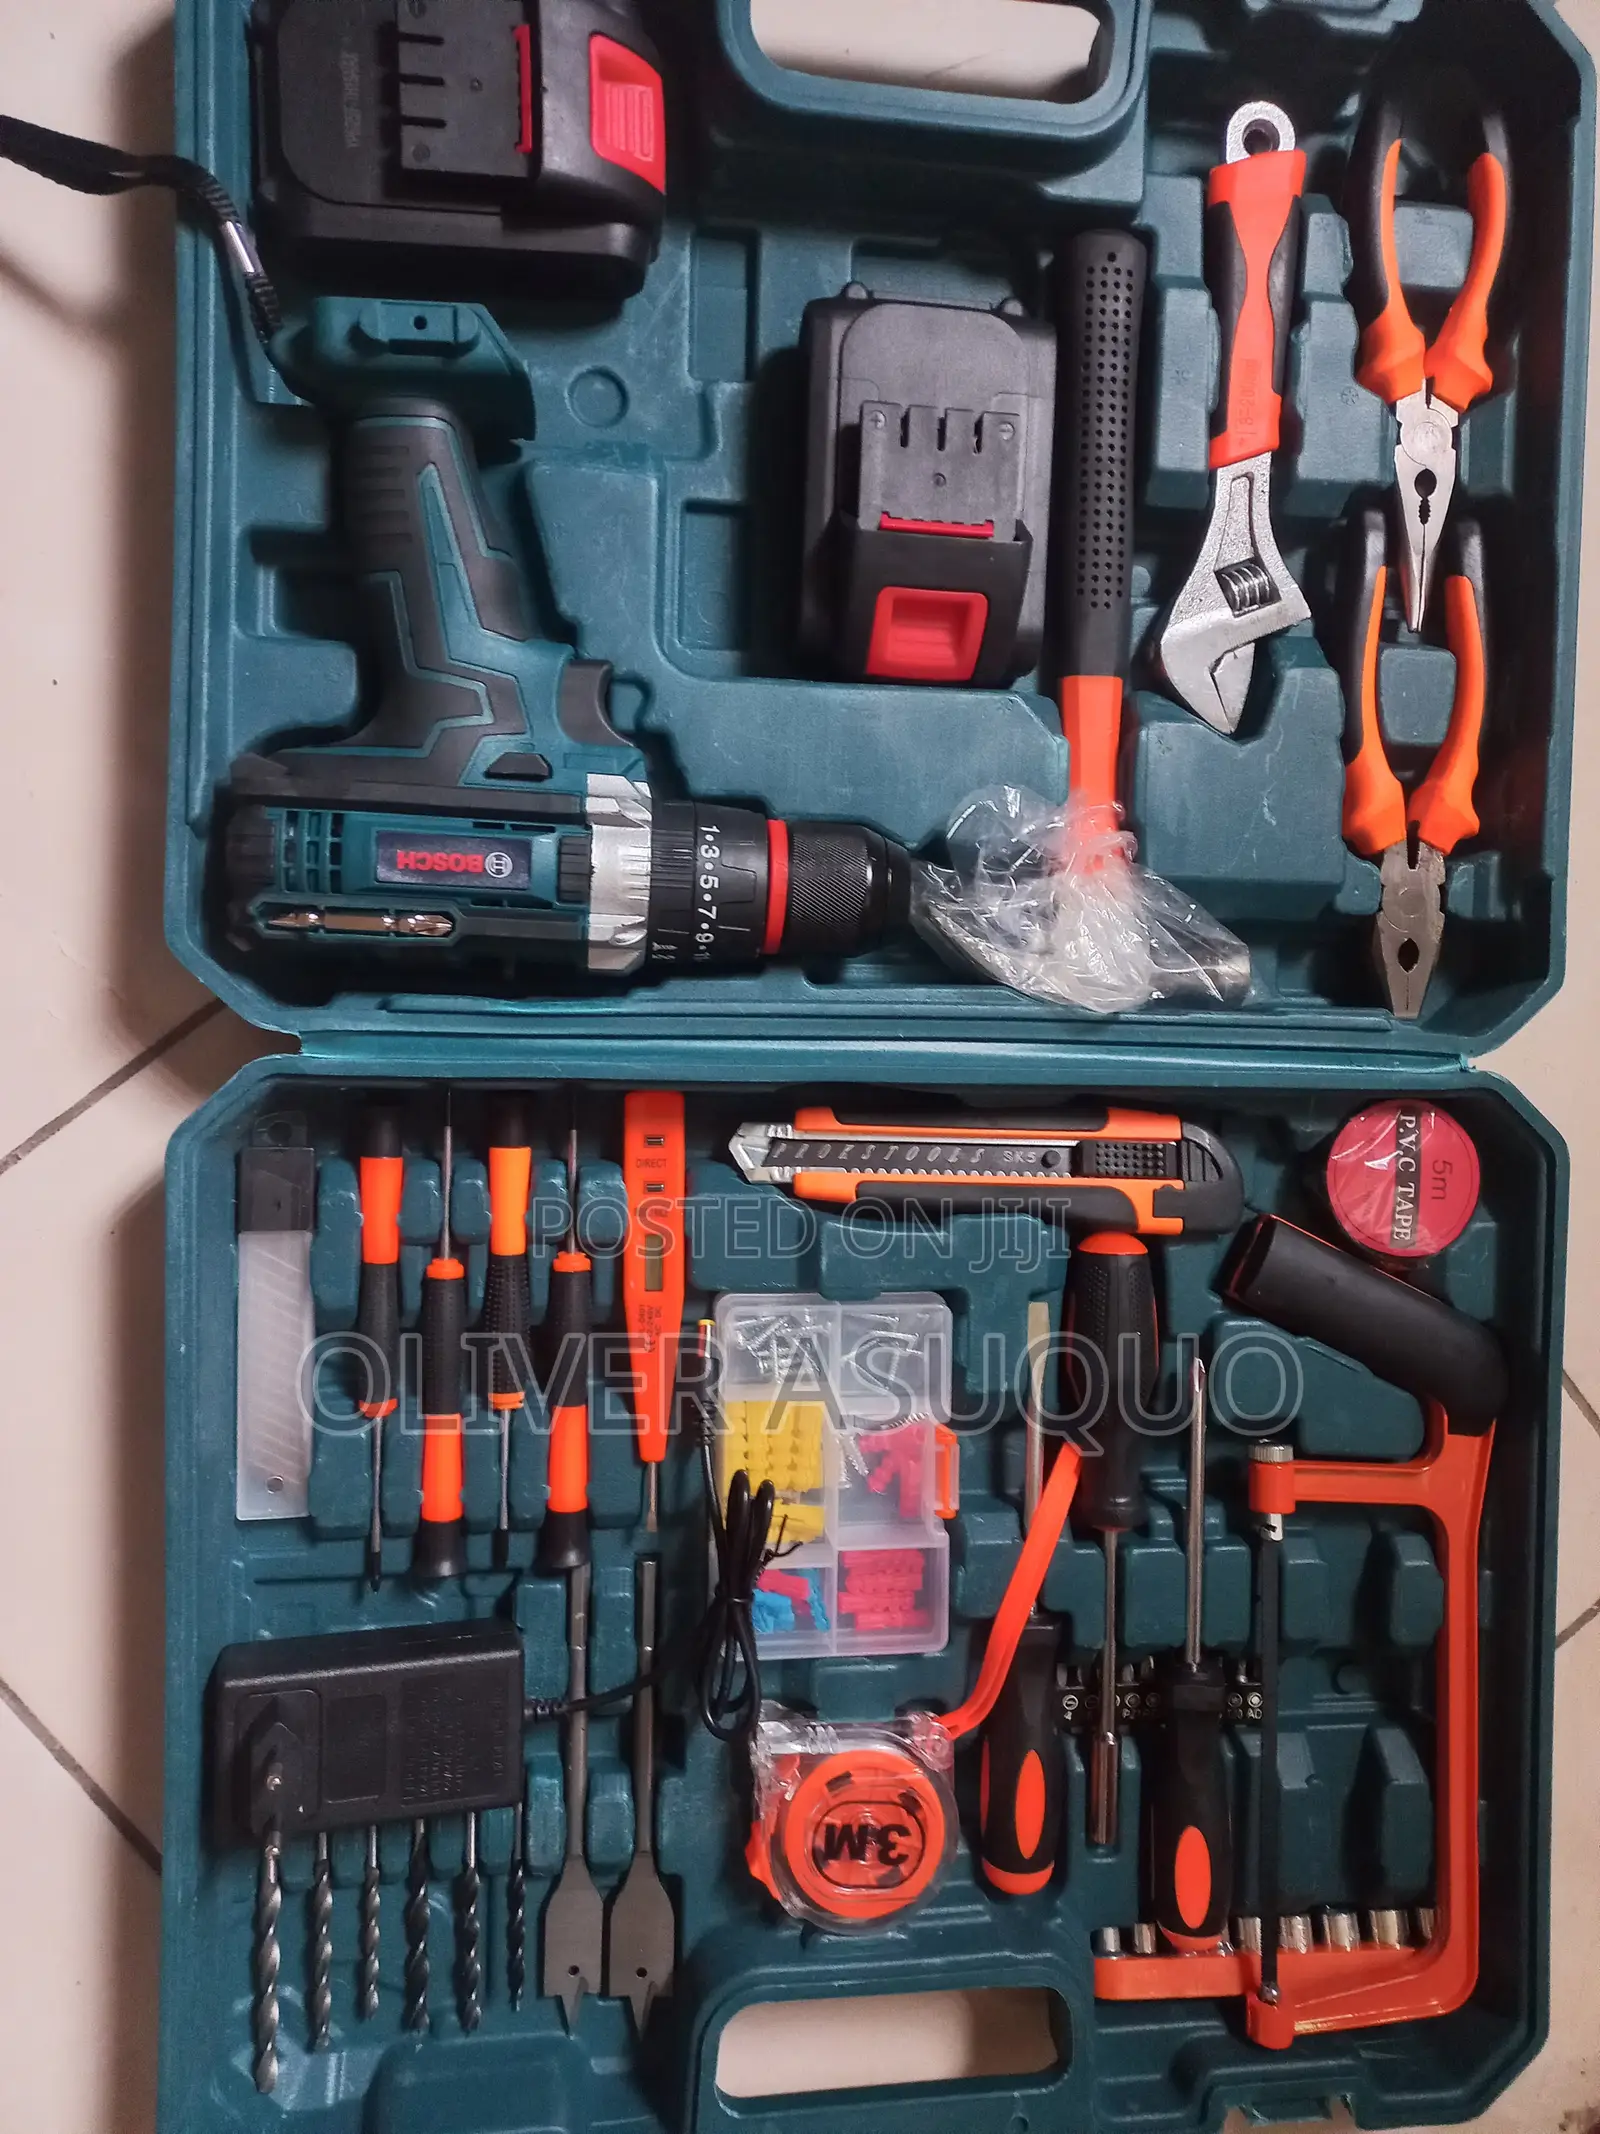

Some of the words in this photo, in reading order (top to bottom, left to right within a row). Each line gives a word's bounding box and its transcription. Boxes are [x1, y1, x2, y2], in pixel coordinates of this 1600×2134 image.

[396, 849, 485, 873] BOSCH
[635, 1157, 668, 1169] DIRECT
[1430, 1159, 1454, 1200] 5m
[1393, 1181, 1416, 1240] TAPE
[822, 1822, 912, 1867] 3M
